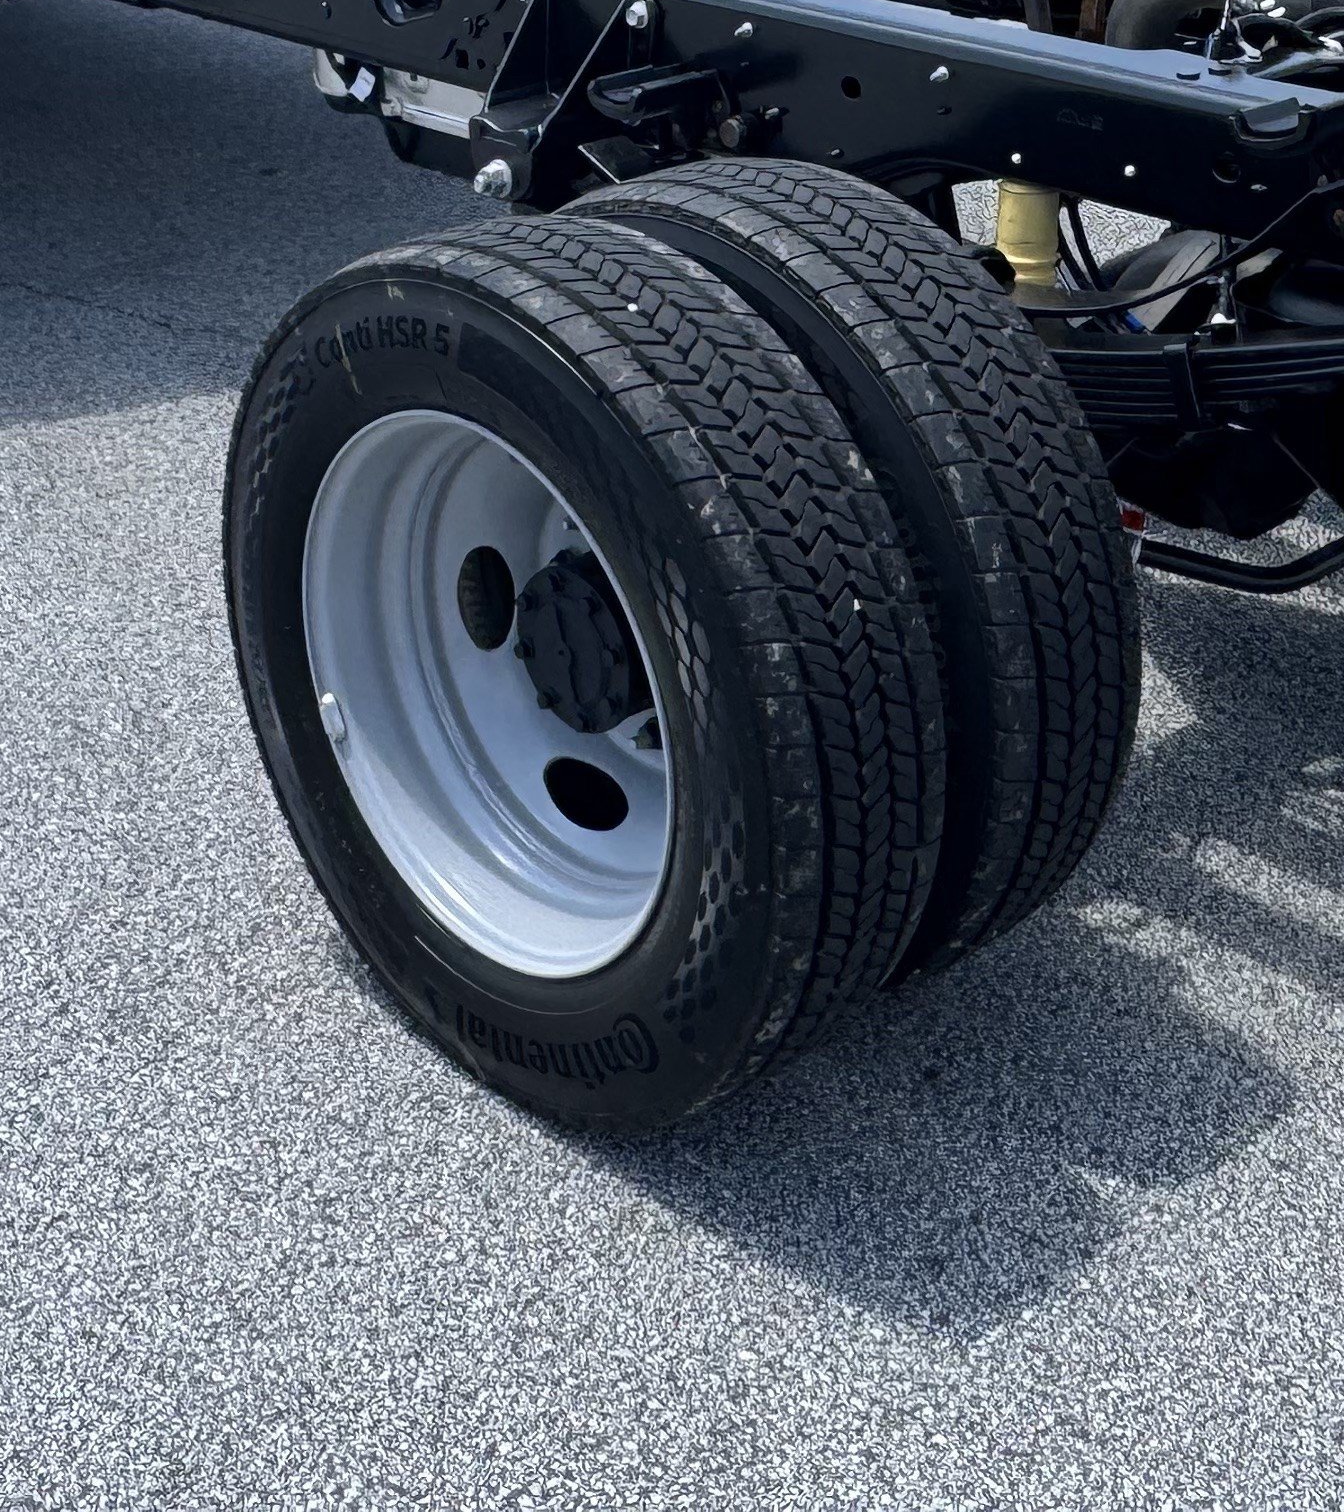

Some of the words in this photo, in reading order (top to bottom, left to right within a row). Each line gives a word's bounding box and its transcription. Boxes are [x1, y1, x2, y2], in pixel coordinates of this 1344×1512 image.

[314, 316, 373, 368] Conti
[376, 315, 428, 351] HSR
[433, 322, 451, 357] 5
[456, 1003, 661, 1090] Continental
